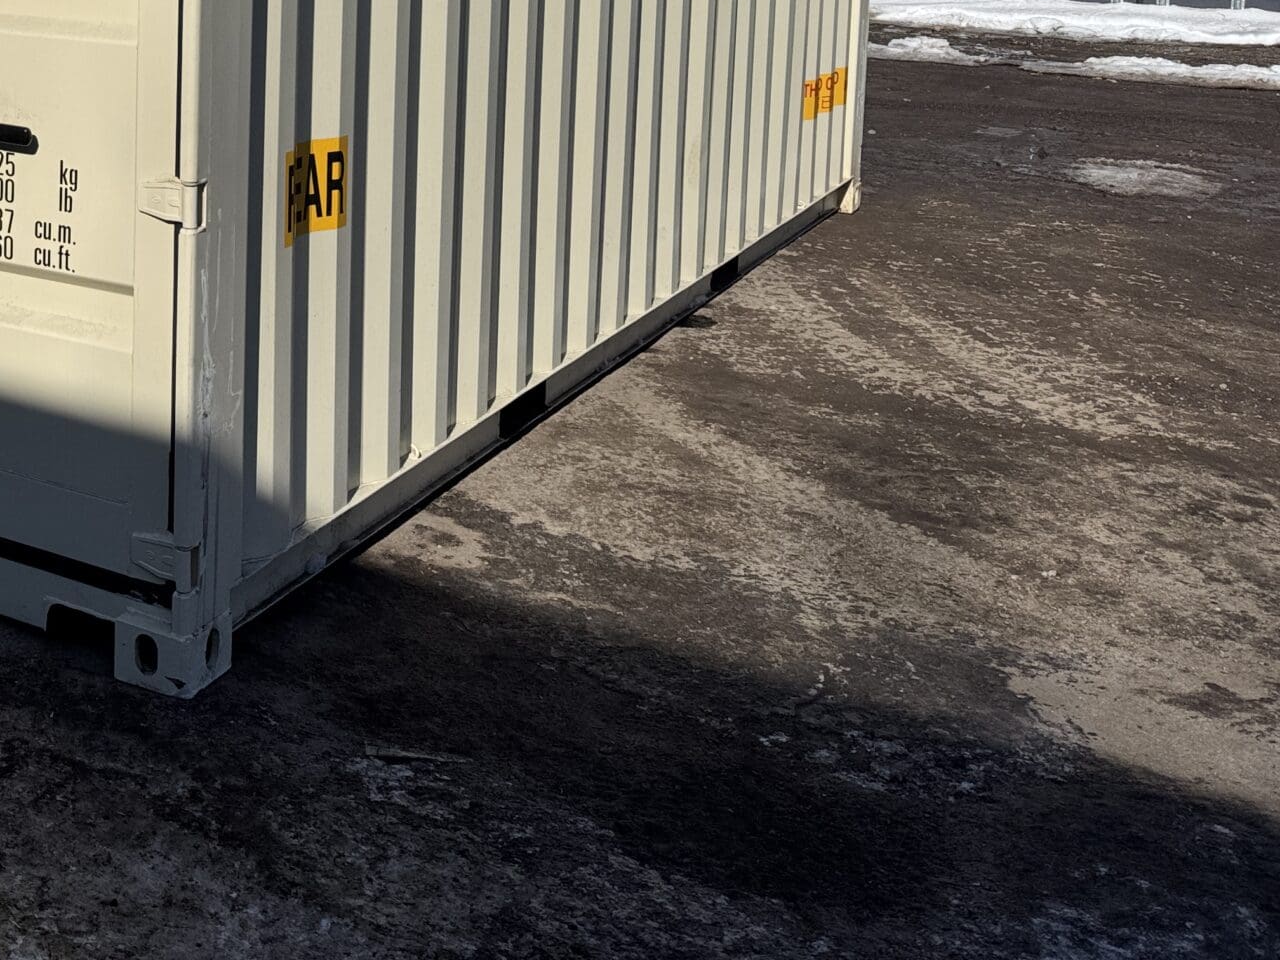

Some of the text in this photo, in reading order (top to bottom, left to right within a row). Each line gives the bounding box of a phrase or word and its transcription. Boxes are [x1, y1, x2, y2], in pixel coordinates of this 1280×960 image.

[59, 159, 78, 192] kg
[59, 186, 73, 213] lb
[34, 220, 76, 246] cu.m.
[34, 245, 76, 273] cu.ft.
